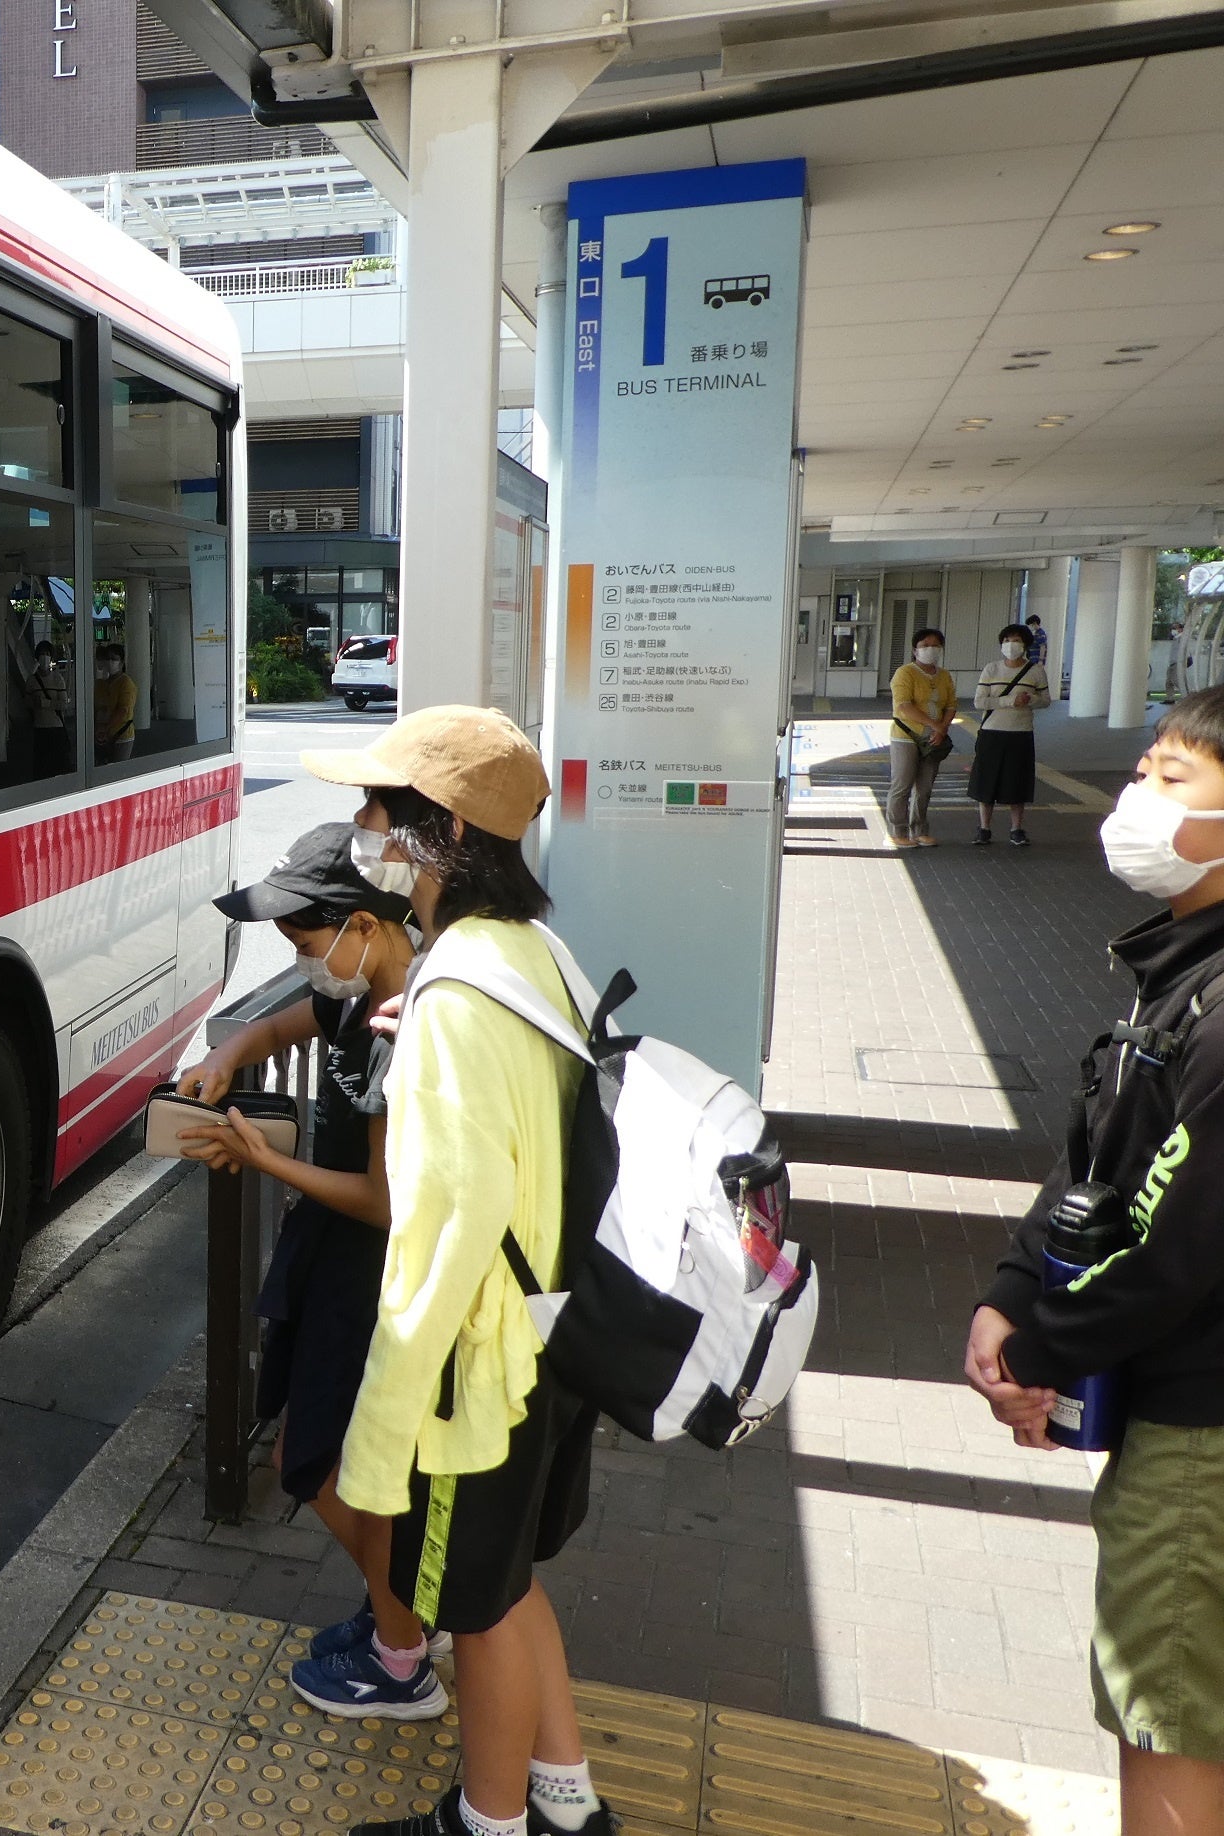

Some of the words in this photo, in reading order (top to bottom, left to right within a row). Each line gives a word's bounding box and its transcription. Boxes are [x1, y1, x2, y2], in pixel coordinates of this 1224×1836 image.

[578, 240, 601, 297] 東口
[621, 236, 668, 366] 1
[578, 320, 597, 372] East
[690, 341, 768, 362] 番乗り場
[617, 379, 657, 396] BUS
[664, 372, 766, 393] TERMINAL
[605, 563, 676, 576] おいでんバス
[684, 565, 736, 574] OIDEN-BUS
[606, 588, 617, 602] 2
[605, 615, 617, 629] 2
[604, 642, 616, 655] 5
[604, 669, 615, 682] 7
[600, 696, 616, 709] 25
[599, 759, 646, 771] 名鉄バス
